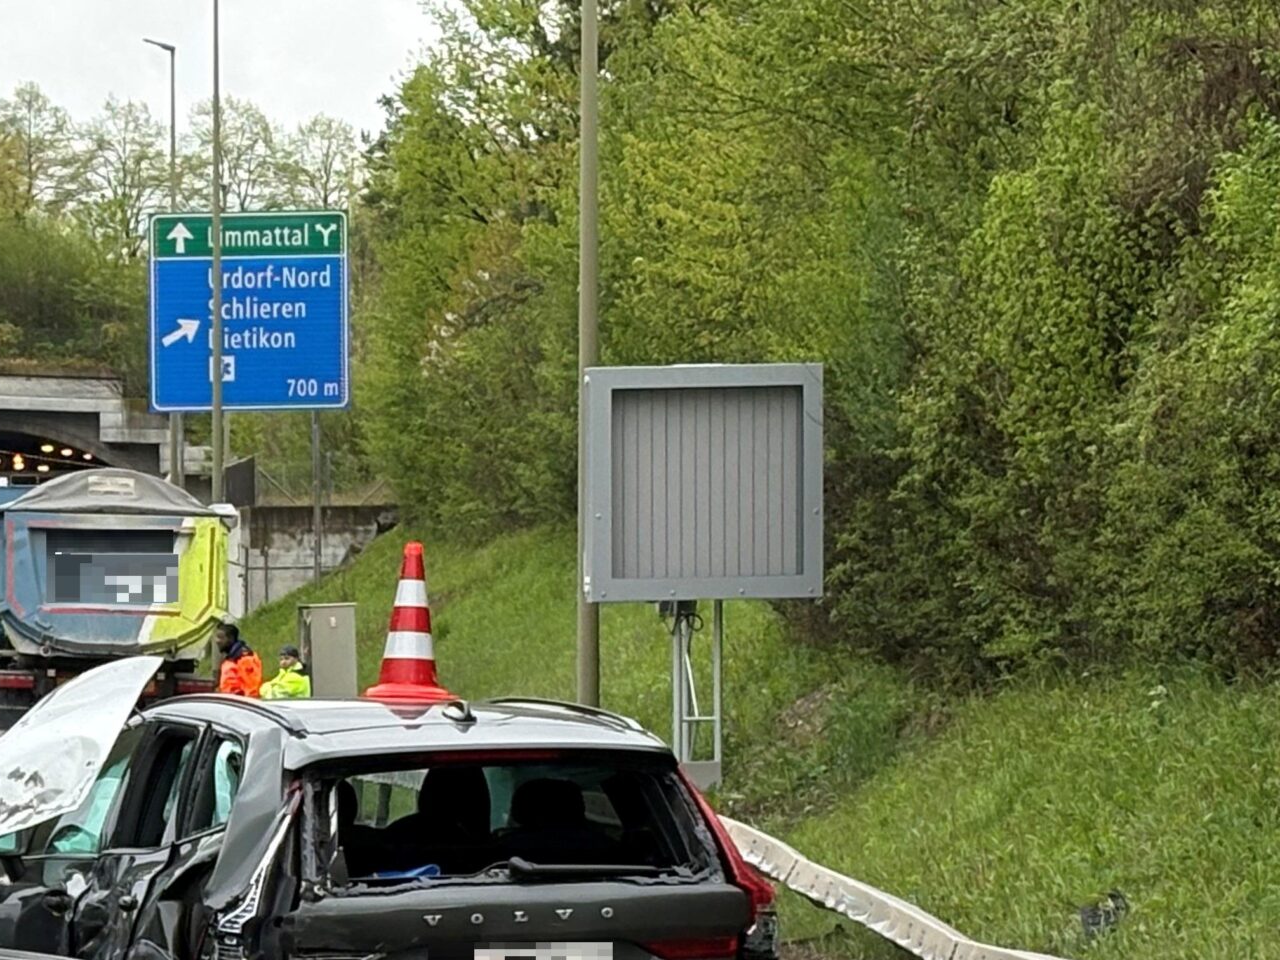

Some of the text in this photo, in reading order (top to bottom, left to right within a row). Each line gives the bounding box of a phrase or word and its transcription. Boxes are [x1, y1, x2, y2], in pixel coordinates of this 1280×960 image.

[286, 379, 339, 397] 700 m
[423, 906, 614, 926] VOLVO
